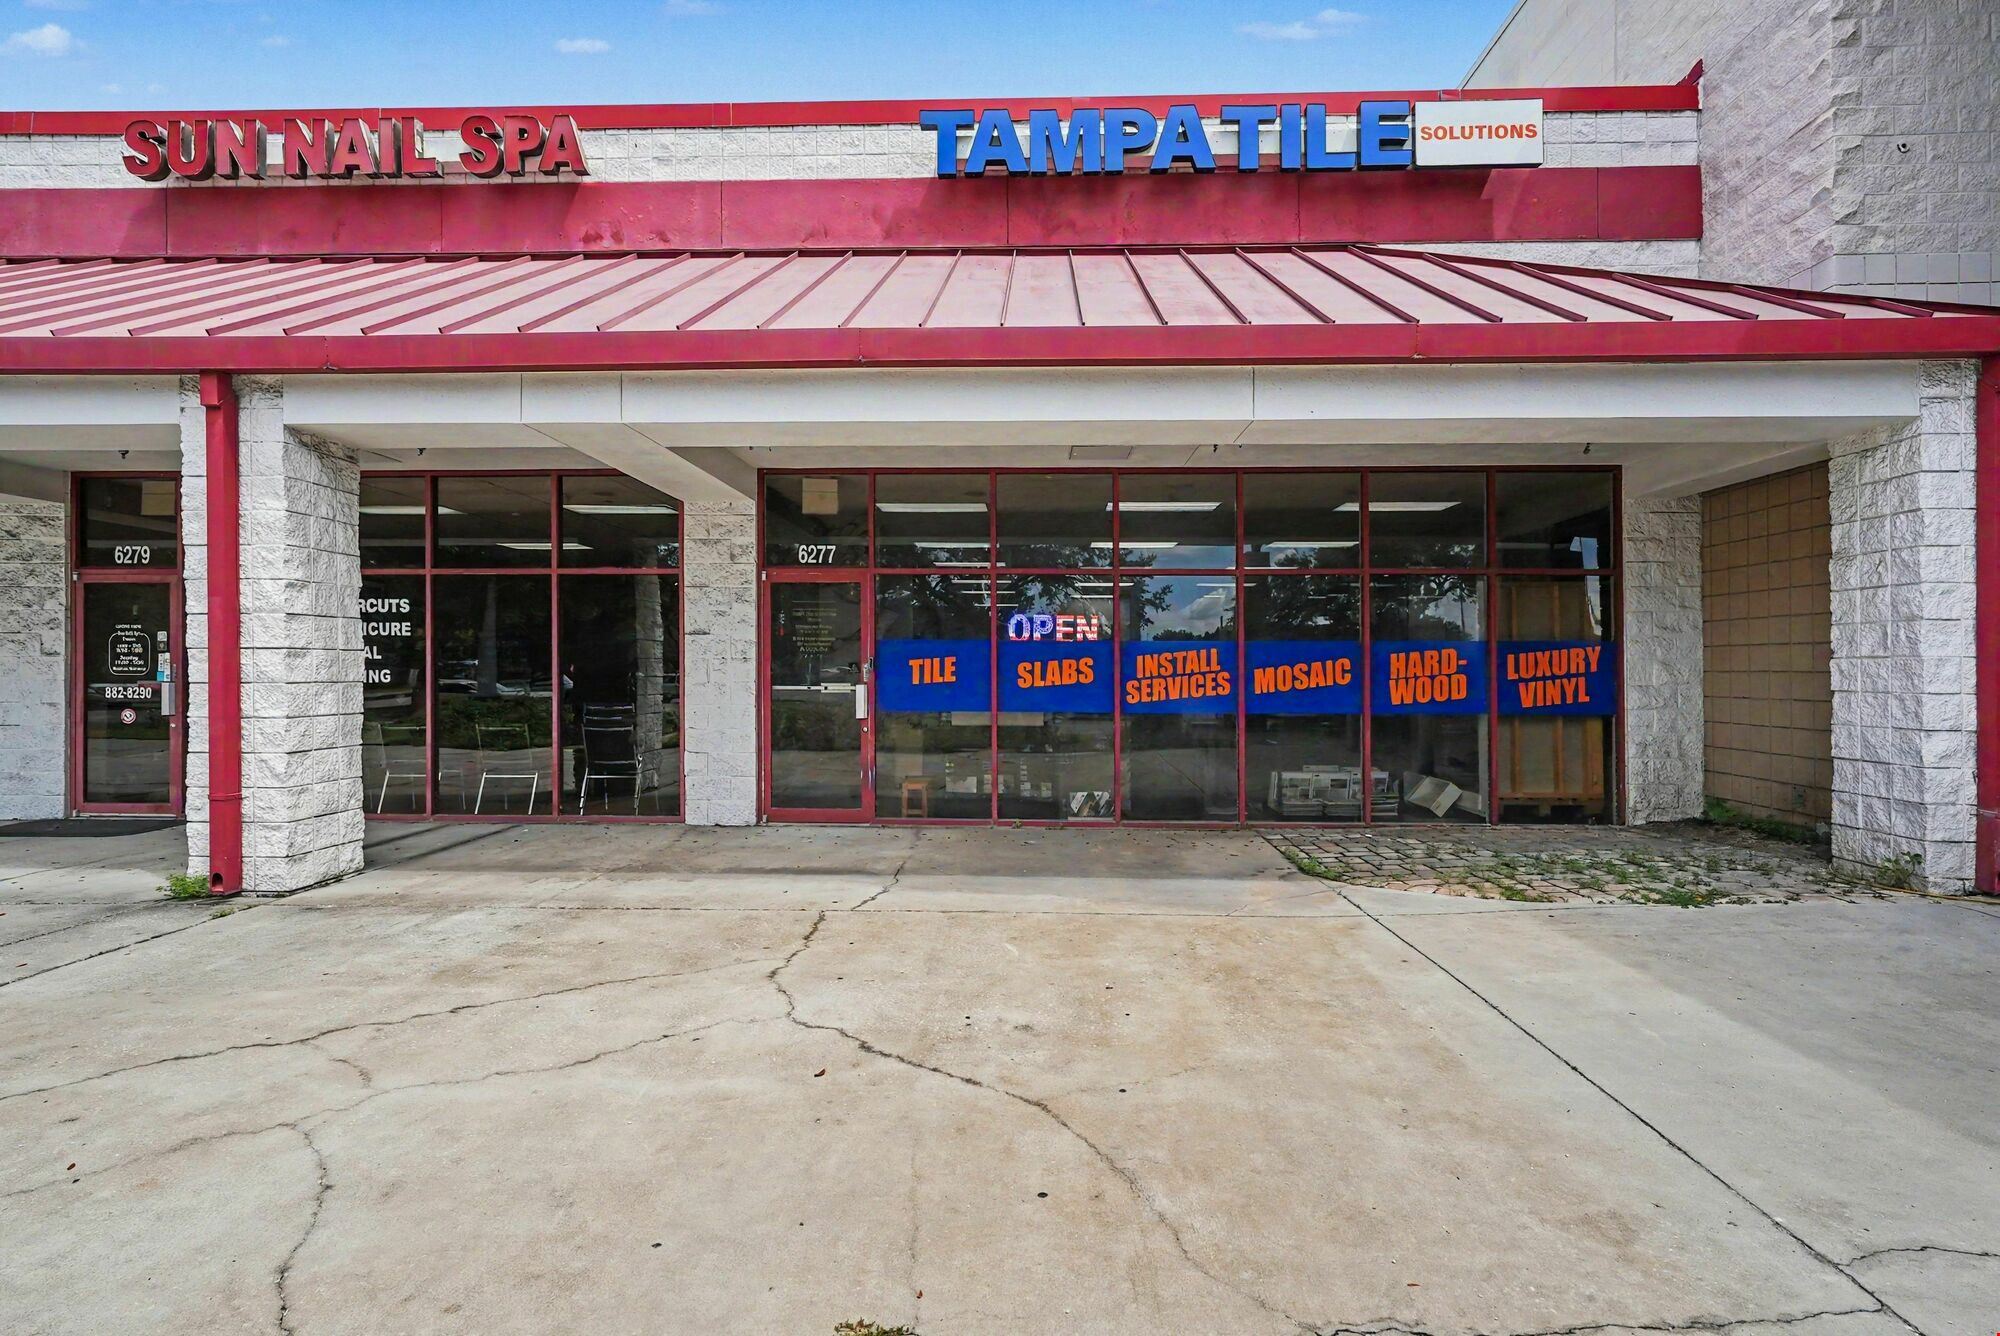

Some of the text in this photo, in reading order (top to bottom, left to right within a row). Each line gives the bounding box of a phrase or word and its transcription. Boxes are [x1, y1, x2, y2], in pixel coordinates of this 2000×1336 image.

[122, 114, 589, 181] SUN NAIL SPA
[919, 100, 1412, 179] TAMPA TILE
[1420, 122, 1538, 142] SOLUTIONS
[114, 545, 150, 564] 6279
[798, 544, 837, 564] 6277
[1007, 613, 1099, 642] OPEN
[908, 656, 956, 685] TILE
[1017, 657, 1094, 689] SLABS
[1136, 648, 1221, 679] INSTALL
[1254, 657, 1351, 695] MOSAIC
[1389, 648, 1468, 680] HARD-
[1507, 645, 1601, 680] LUXURY
[104, 686, 152, 699] 882-8290
[1125, 671, 1231, 705] SERVICES
[1388, 673, 1467, 705] WOOD
[1518, 676, 1590, 708] VINYL
